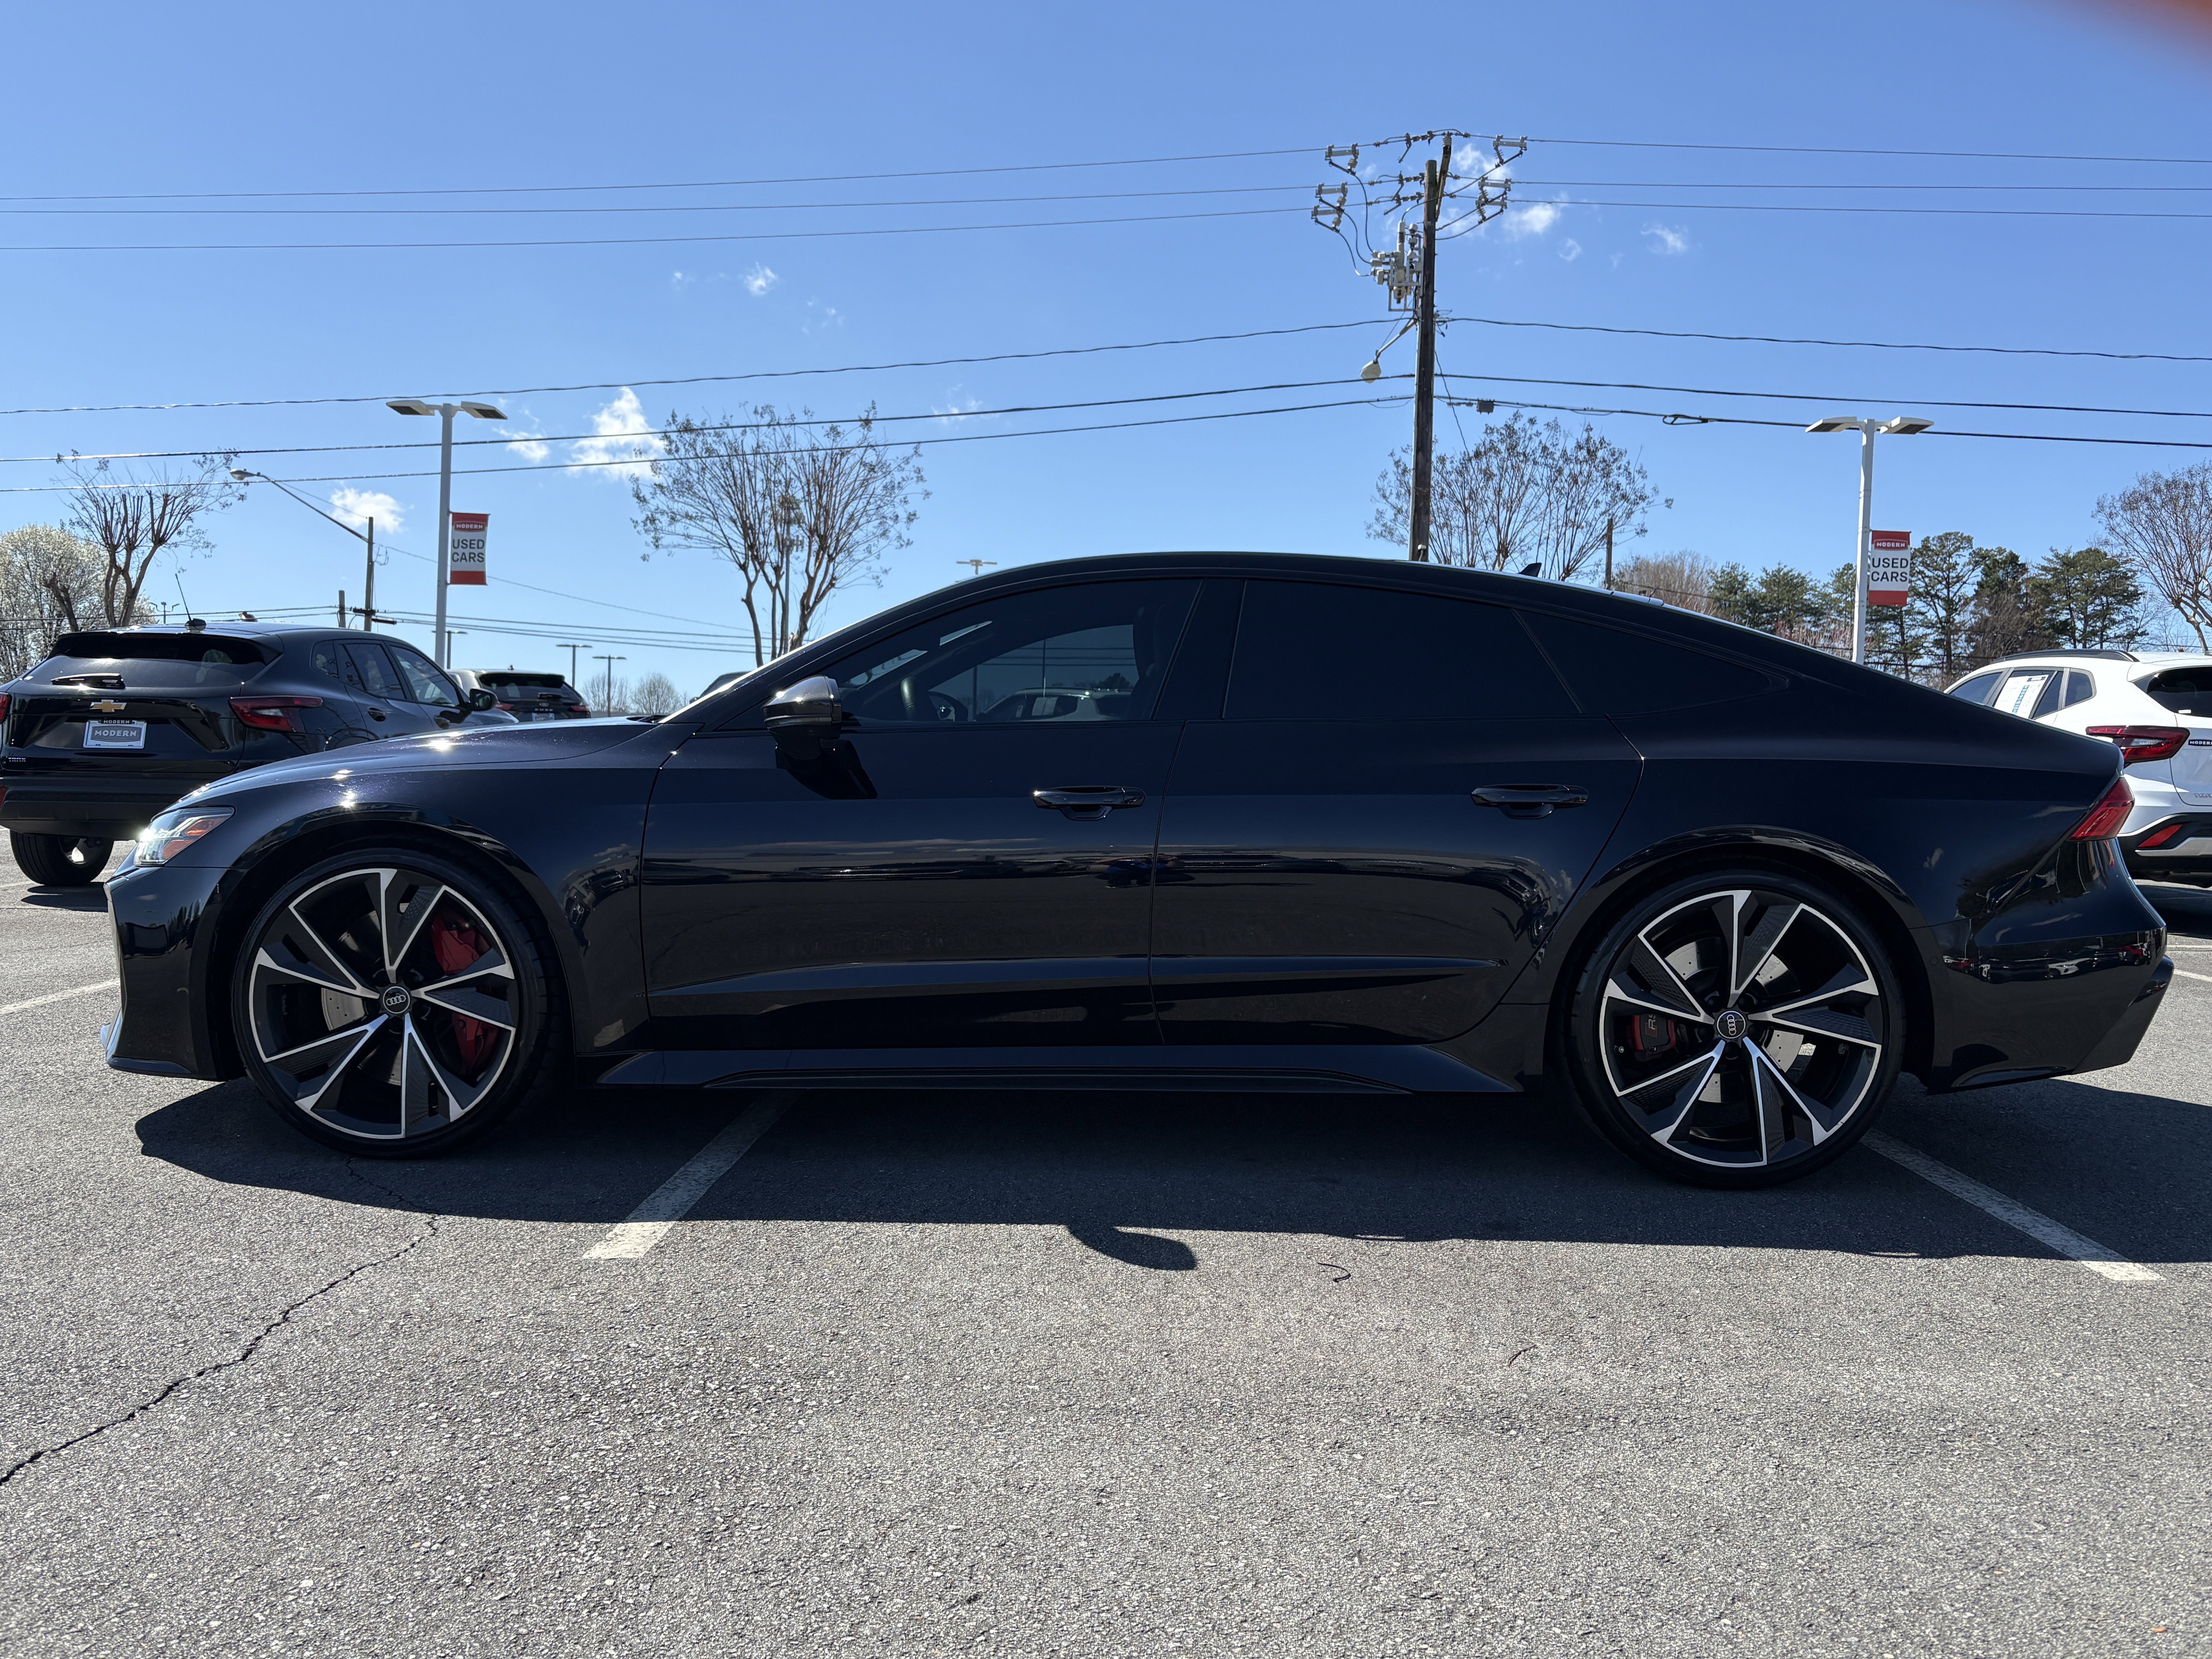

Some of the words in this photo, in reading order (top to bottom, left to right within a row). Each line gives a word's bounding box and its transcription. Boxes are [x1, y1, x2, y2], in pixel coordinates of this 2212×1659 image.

[453, 539, 484, 550] USED
[452, 552, 484, 563] CARS
[1872, 558, 1909, 568] USED
[1871, 571, 1908, 582] CARS
